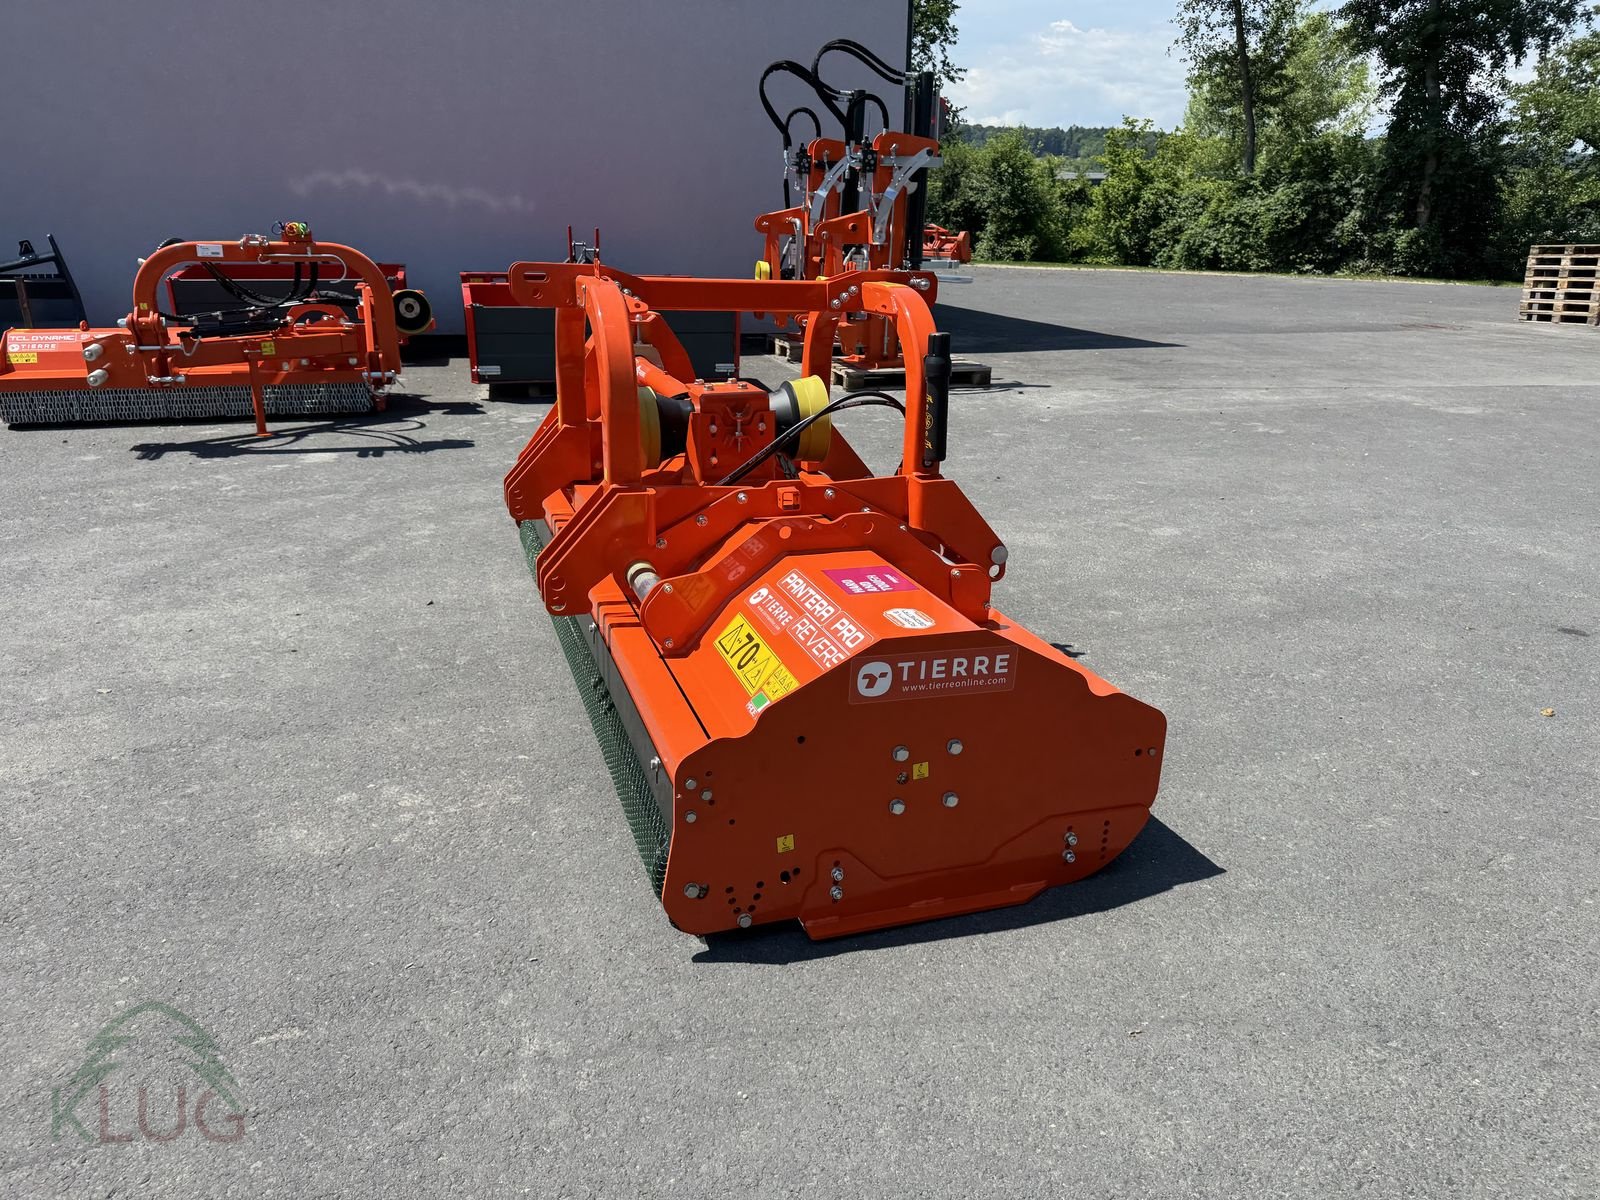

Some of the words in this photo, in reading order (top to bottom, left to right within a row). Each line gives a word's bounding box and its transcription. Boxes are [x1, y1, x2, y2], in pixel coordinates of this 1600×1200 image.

[762, 594, 793, 626] TIERRE
[781, 573, 835, 621] PANTERA
[831, 618, 864, 648] PRO
[730, 632, 760, 670] 70
[897, 654, 1010, 681] TIERRE
[902, 676, 1007, 692] www.tierreonline.com
